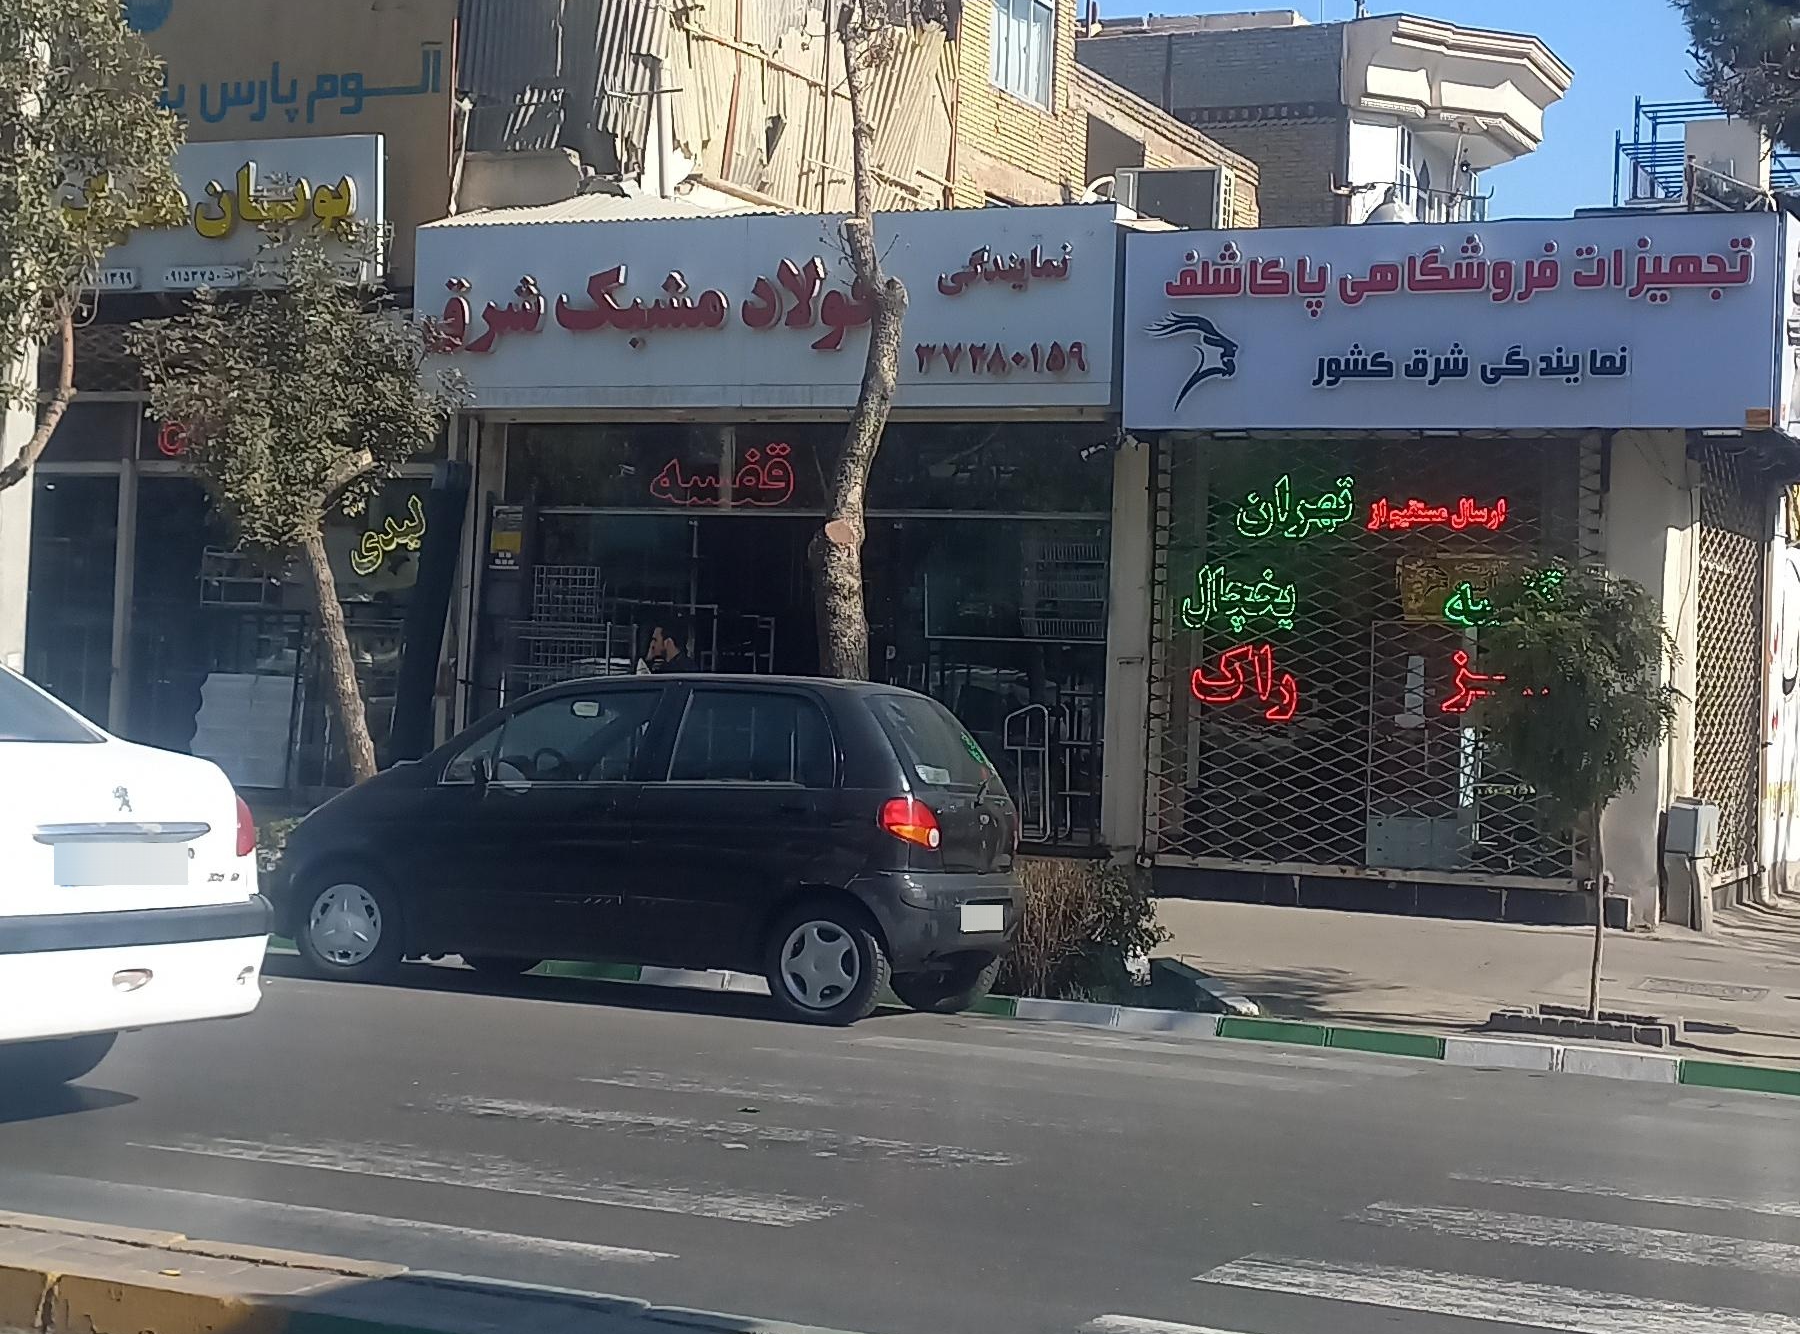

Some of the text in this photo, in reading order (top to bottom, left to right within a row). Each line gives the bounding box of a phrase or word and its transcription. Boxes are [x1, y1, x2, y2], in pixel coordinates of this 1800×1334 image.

[199, 61, 299, 124] پارس
[937, 241, 1074, 296] نمایندگی
[1339, 234, 1561, 306] فروشگاهی
[1573, 236, 1755, 304] تجهیزات
[424, 274, 546, 354] شرق
[555, 264, 730, 349] مشبک
[914, 339, 1087, 373] ۳۷۲۸۰۱۵۹
[1311, 342, 1629, 387] نمایندگی شرق کشور
[650, 442, 795, 508] قفسه
[1236, 474, 1507, 538] ارسال مستقیم از تهران
[350, 494, 426, 575] لیدی
[1182, 564, 1296, 633] یخچال
[1191, 644, 1297, 720] راک
